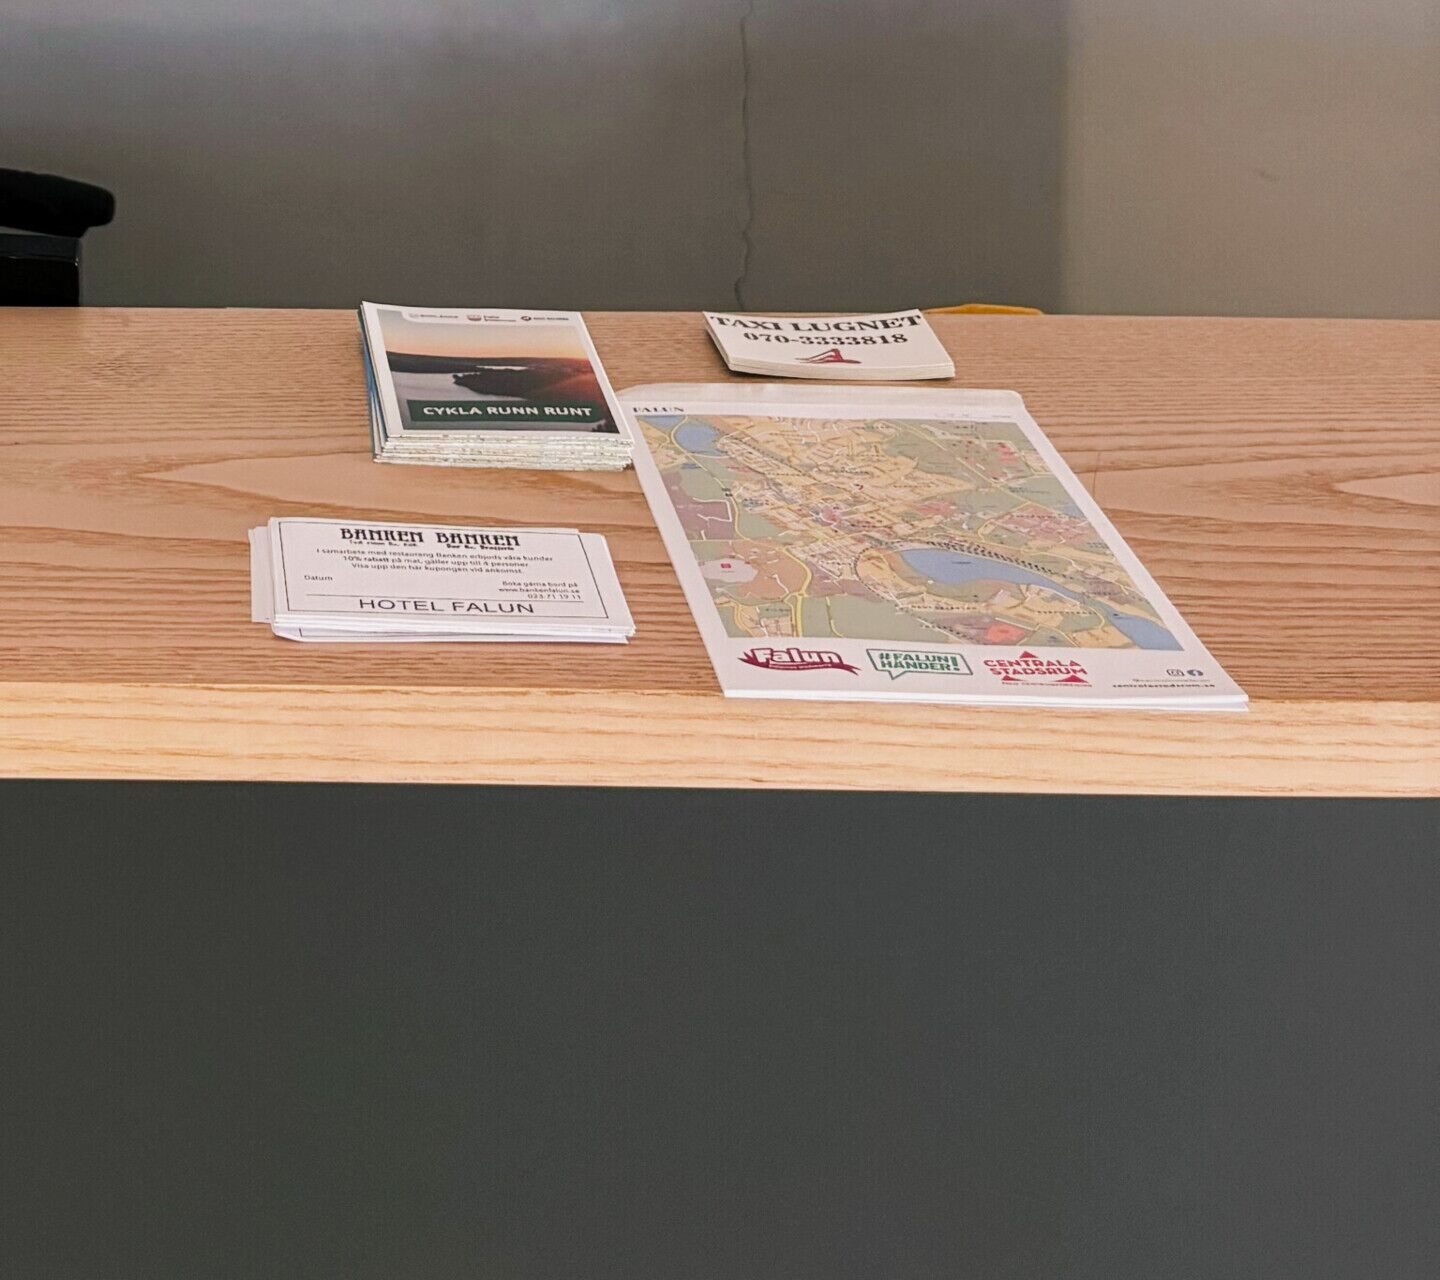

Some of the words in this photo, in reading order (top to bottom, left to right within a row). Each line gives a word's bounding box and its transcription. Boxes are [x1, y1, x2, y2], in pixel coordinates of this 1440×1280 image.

[710, 315, 782, 331] TAXI
[794, 314, 922, 332] LUGNET
[744, 332, 908, 345] 070-3333818
[423, 406, 482, 416] CYKLA
[486, 406, 539, 416] RUNN
[544, 407, 592, 416] RUNT
[340, 528, 424, 543] BANKEN
[435, 532, 520, 546] BANKEN
[389, 551, 434, 559] restaurang
[359, 599, 444, 611] HOTEL
[452, 601, 535, 613] FALUN
[751, 648, 842, 663] Falun
[879, 652, 949, 662] #FALUN
[983, 659, 1081, 667] CENTRALA
